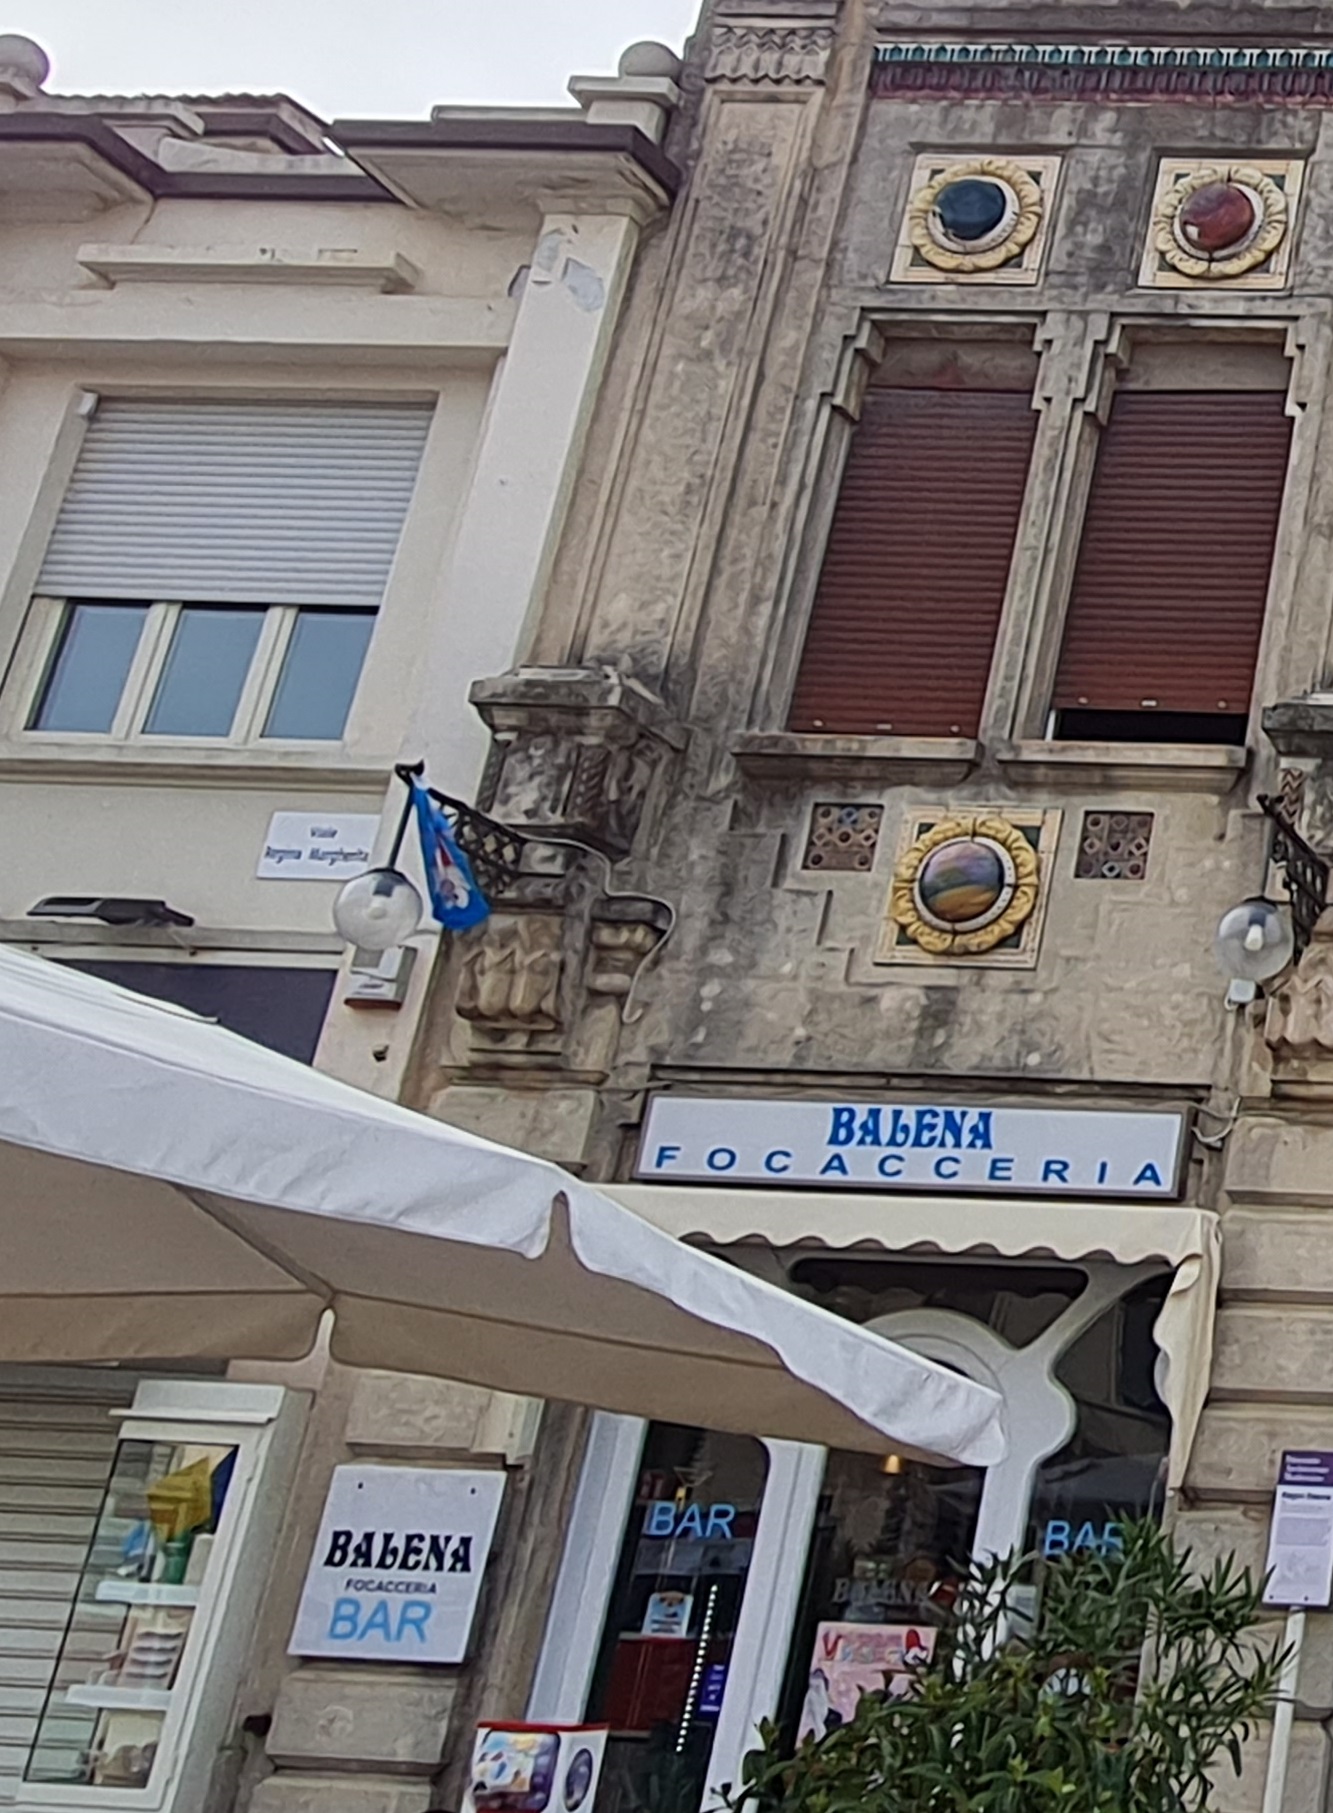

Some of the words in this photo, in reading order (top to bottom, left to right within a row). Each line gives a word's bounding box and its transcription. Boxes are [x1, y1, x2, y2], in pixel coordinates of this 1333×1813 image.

[826, 1106, 994, 1149] BALENA
[655, 1145, 1162, 1187] FOCACCERIA
[643, 1500, 736, 1541] BAR
[323, 1529, 473, 1573] BALENA
[344, 1578, 437, 1594] FOCACCERIA
[328, 1597, 433, 1643] BAR
